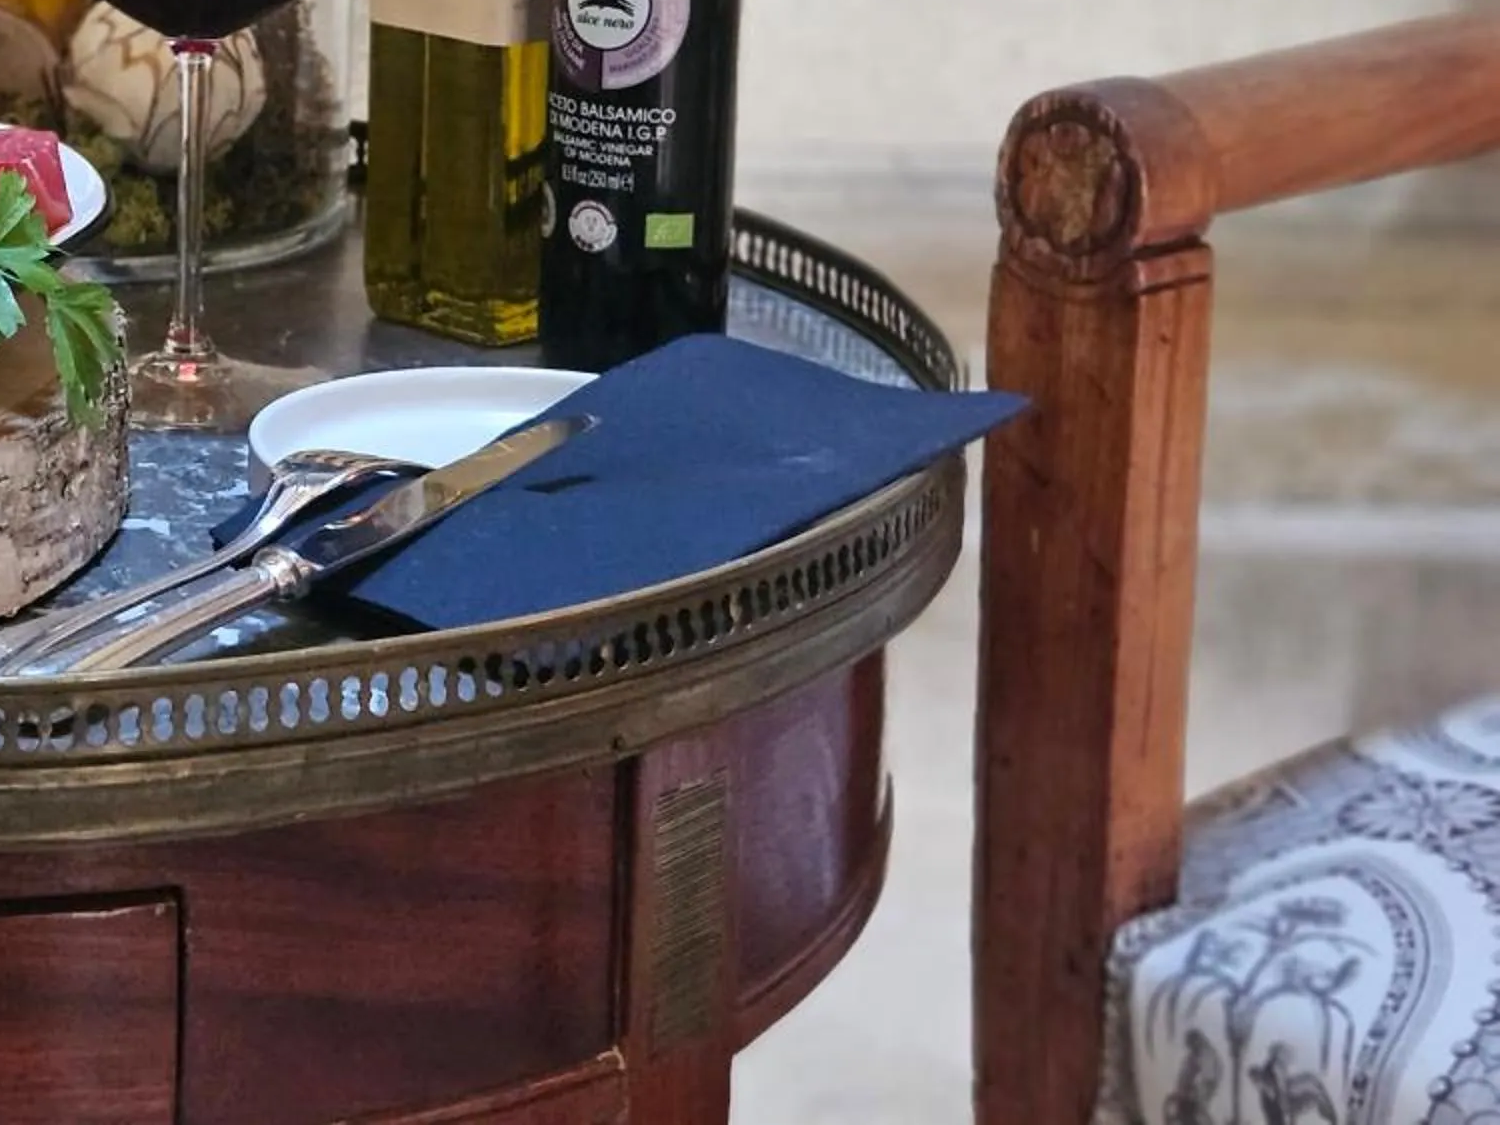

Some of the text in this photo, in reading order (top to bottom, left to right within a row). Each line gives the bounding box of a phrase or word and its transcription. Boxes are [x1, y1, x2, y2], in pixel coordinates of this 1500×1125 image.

[580, 101, 676, 124] BALSAMICO
[560, 112, 623, 139] MODENA
[579, 149, 631, 168] MODENA
[600, 141, 654, 156] VINEGAR
